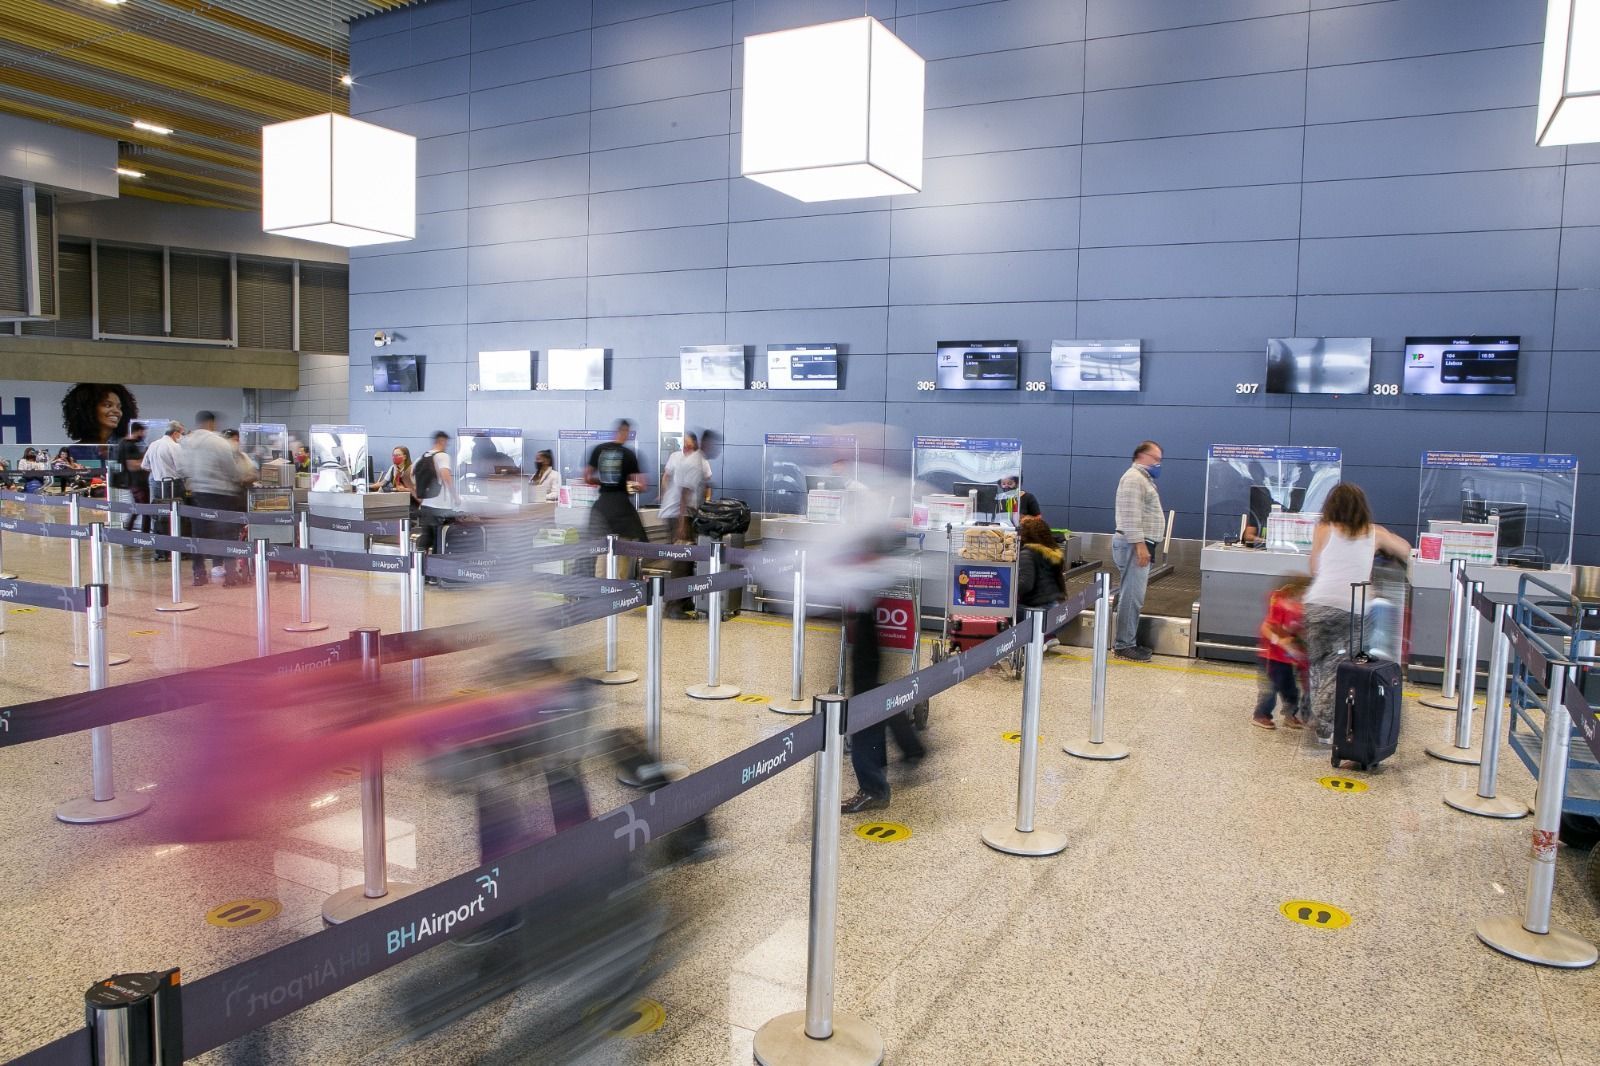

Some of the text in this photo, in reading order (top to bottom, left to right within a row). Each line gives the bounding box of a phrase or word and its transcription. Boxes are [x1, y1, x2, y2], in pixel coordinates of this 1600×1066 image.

[665, 382, 680, 390] 303
[750, 381, 767, 390] 304
[917, 381, 936, 390] 305
[1026, 382, 1046, 391] 306
[1236, 383, 1259, 394] 307
[1373, 384, 1398, 395] 308
[658, 550, 687, 558] BHAirport
[372, 560, 399, 570] BHAirport
[457, 568, 485, 580] BHAirport
[688, 583, 709, 592] BHAirport
[612, 596, 639, 609] BHAirport
[886, 690, 914, 711] BHAirport
[742, 750, 786, 784] BHAirport
[386, 894, 485, 954] BHAirport
